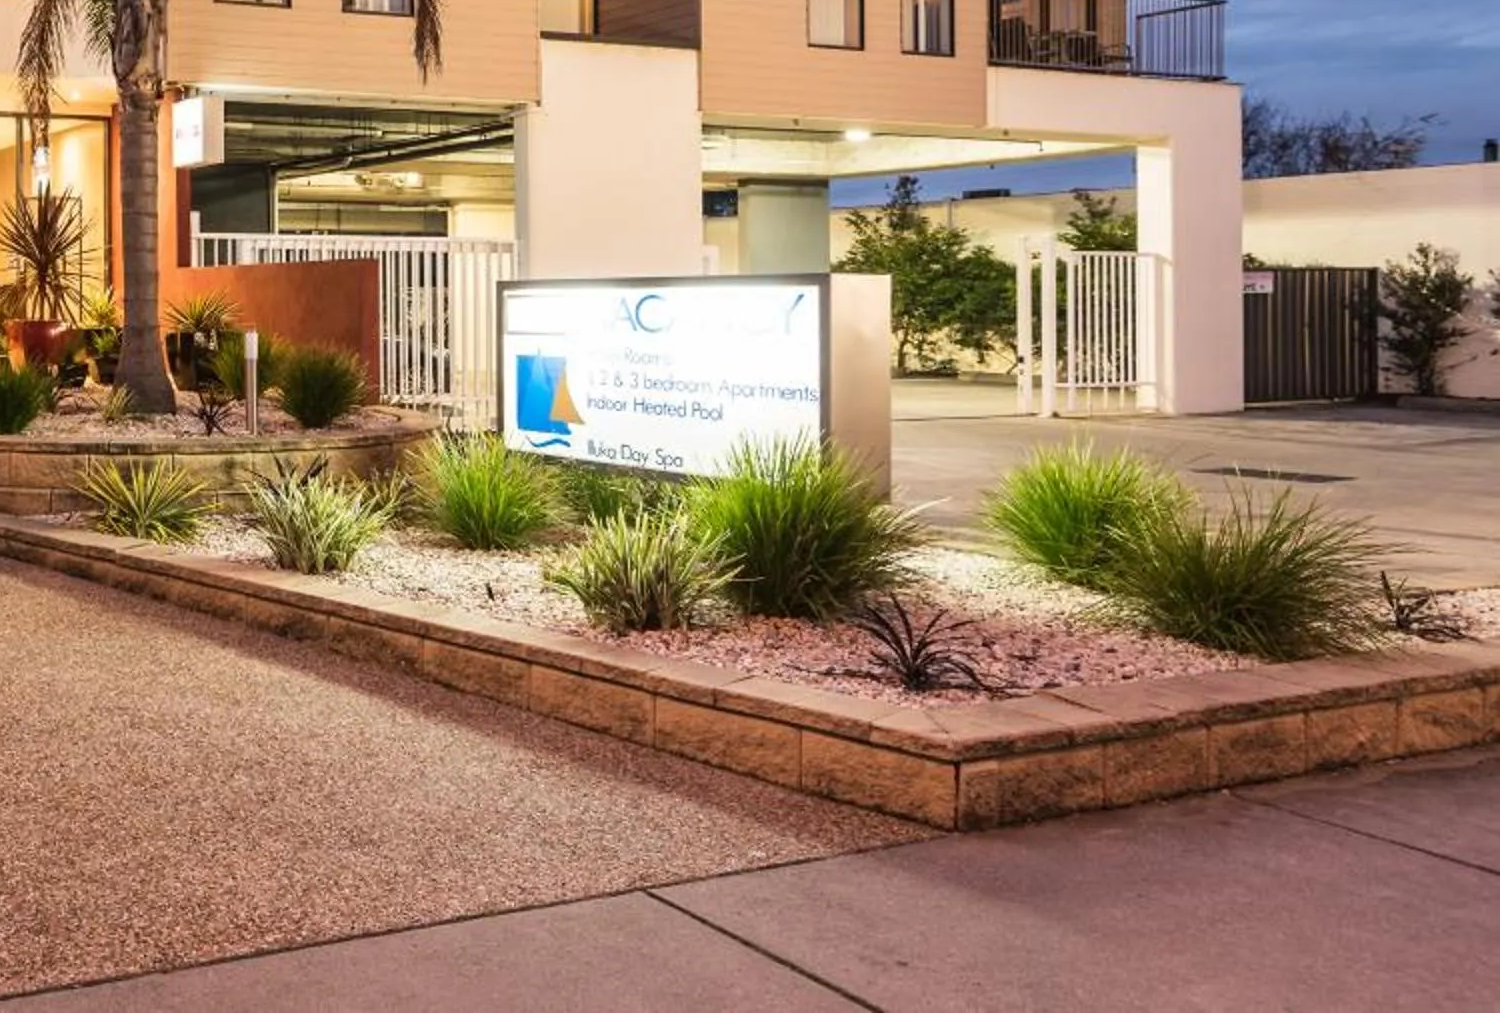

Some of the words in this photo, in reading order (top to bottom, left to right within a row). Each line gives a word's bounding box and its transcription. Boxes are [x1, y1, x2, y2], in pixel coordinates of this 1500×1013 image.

[630, 371, 640, 389] 3
[718, 378, 819, 404] Apartments
[587, 391, 628, 412] Indoor
[633, 395, 688, 419] Heated
[691, 400, 724, 422] Pool
[621, 444, 649, 467] Day
[655, 448, 684, 470] Spa
